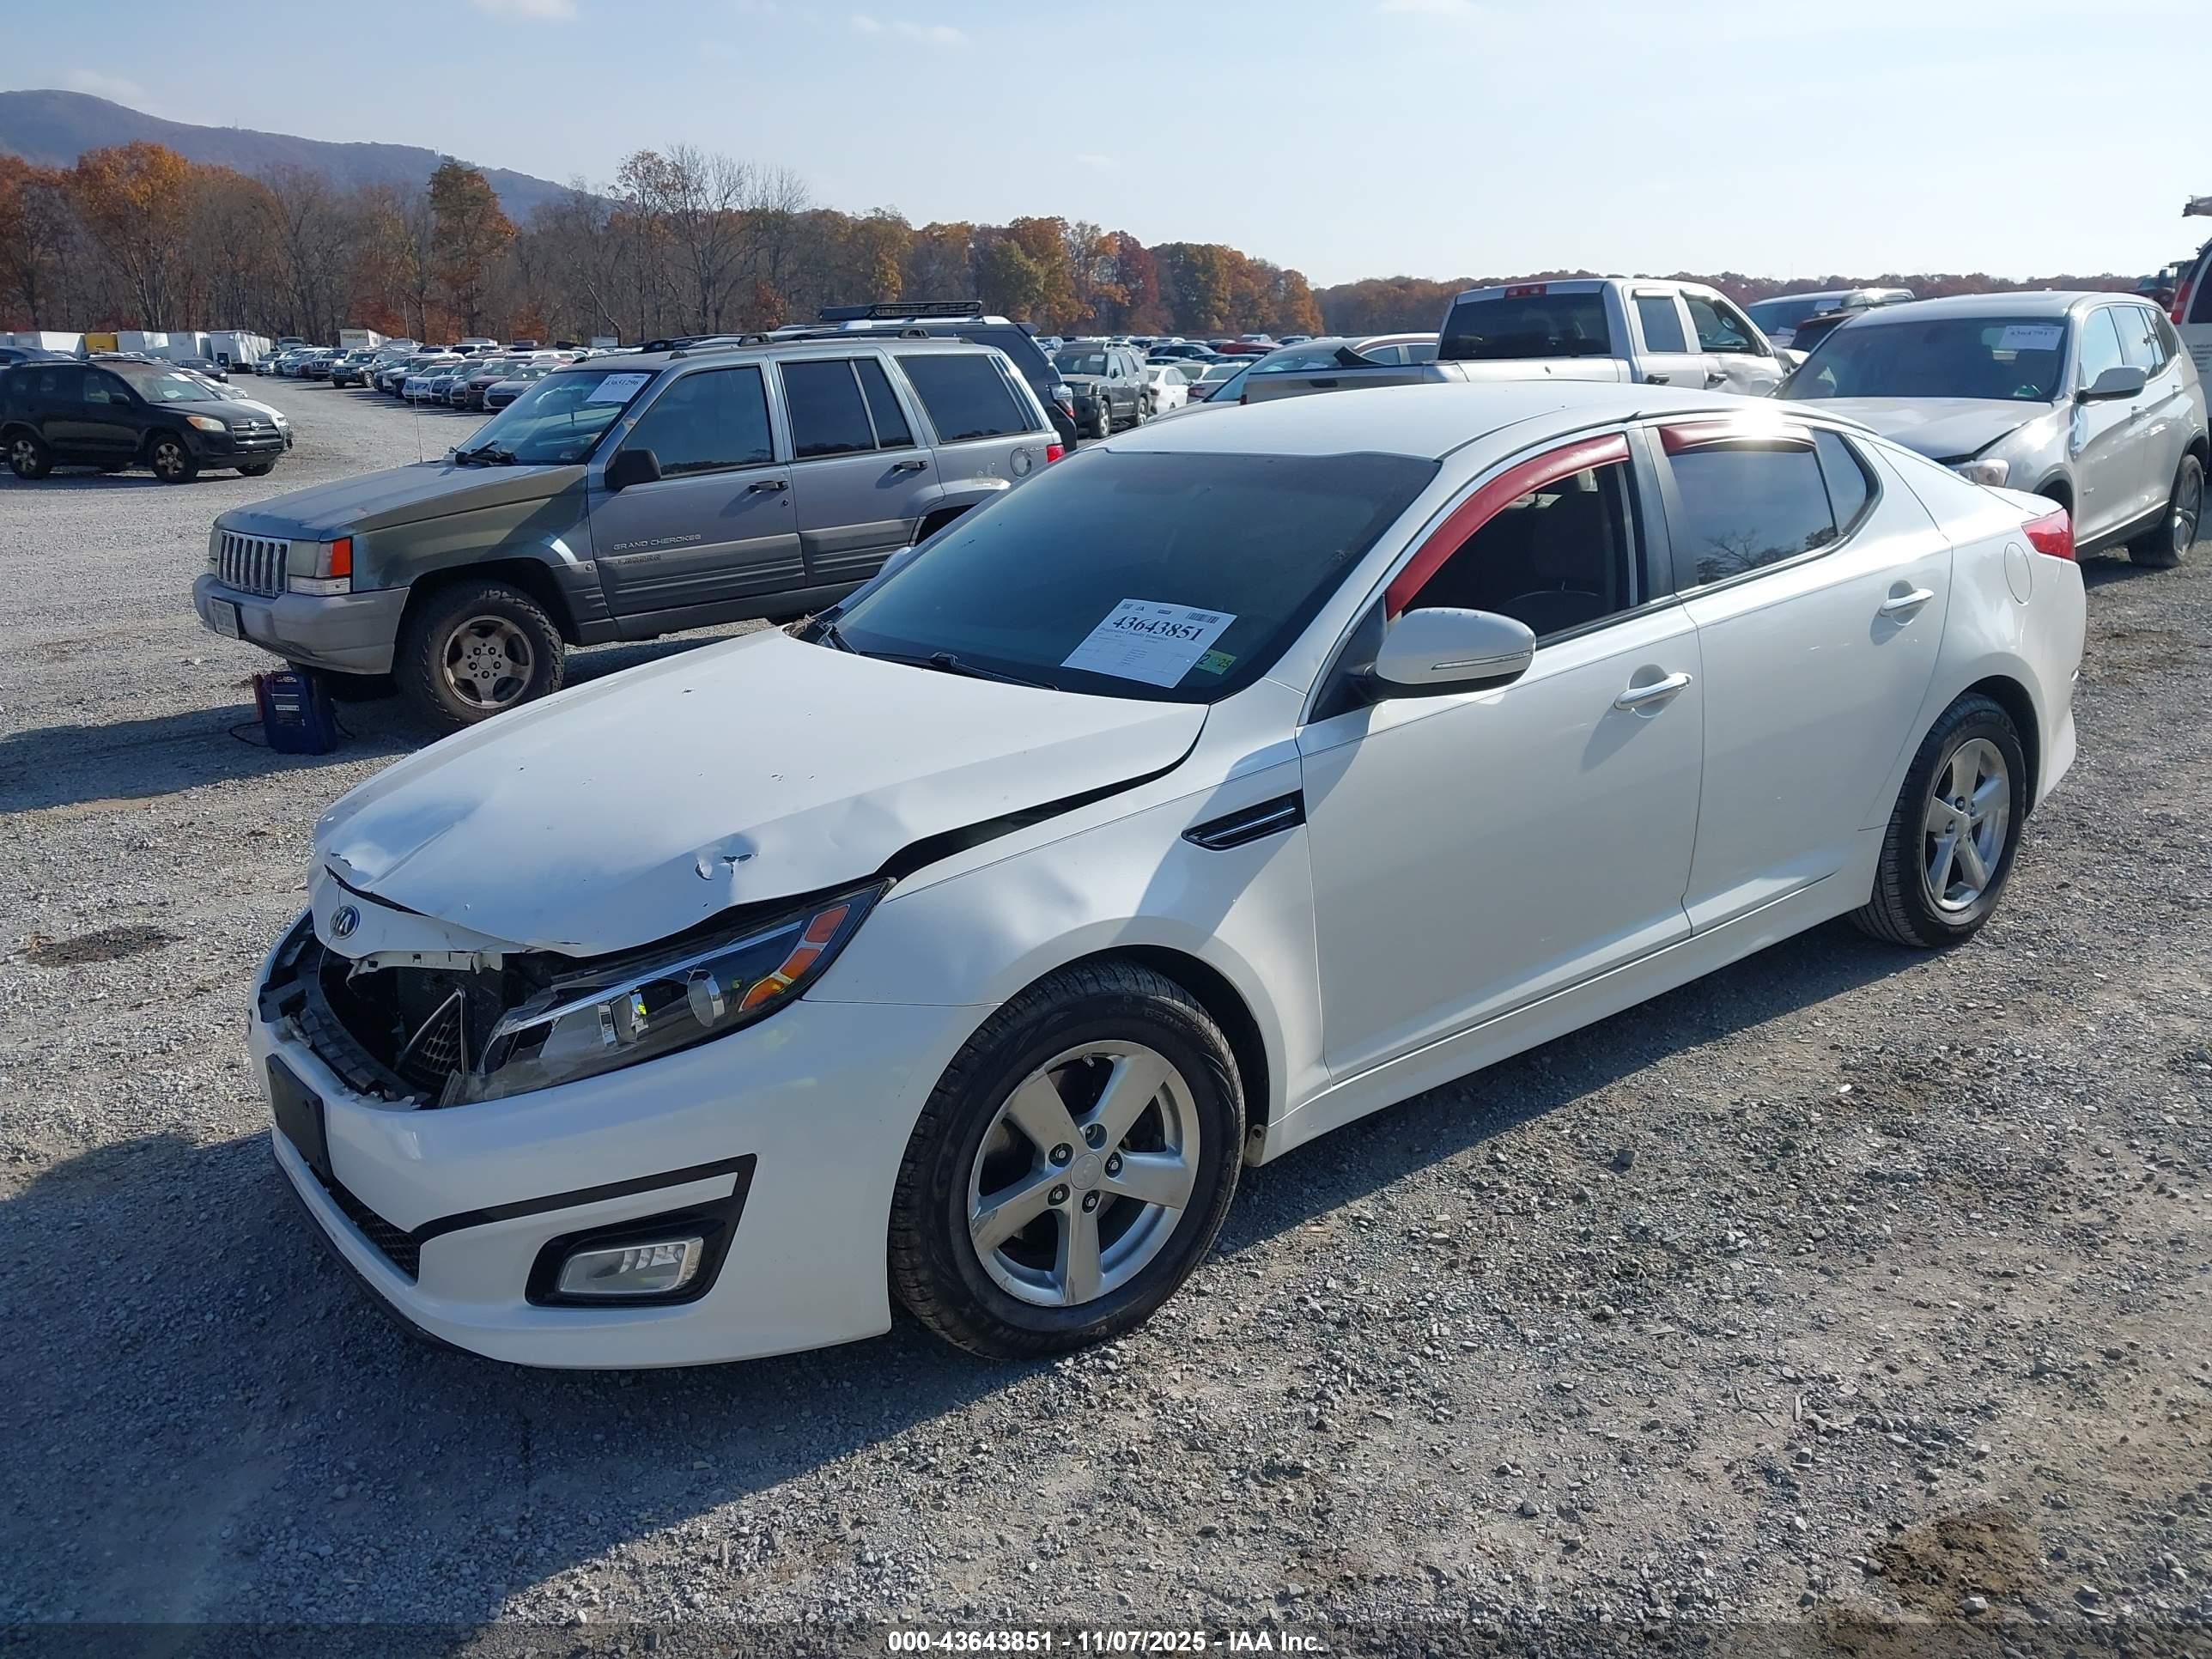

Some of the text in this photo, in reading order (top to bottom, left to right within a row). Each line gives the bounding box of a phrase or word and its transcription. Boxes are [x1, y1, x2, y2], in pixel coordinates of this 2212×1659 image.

[613, 533, 702, 550] GRAND CHEROKEE
[1113, 615, 1205, 641] 43643851
